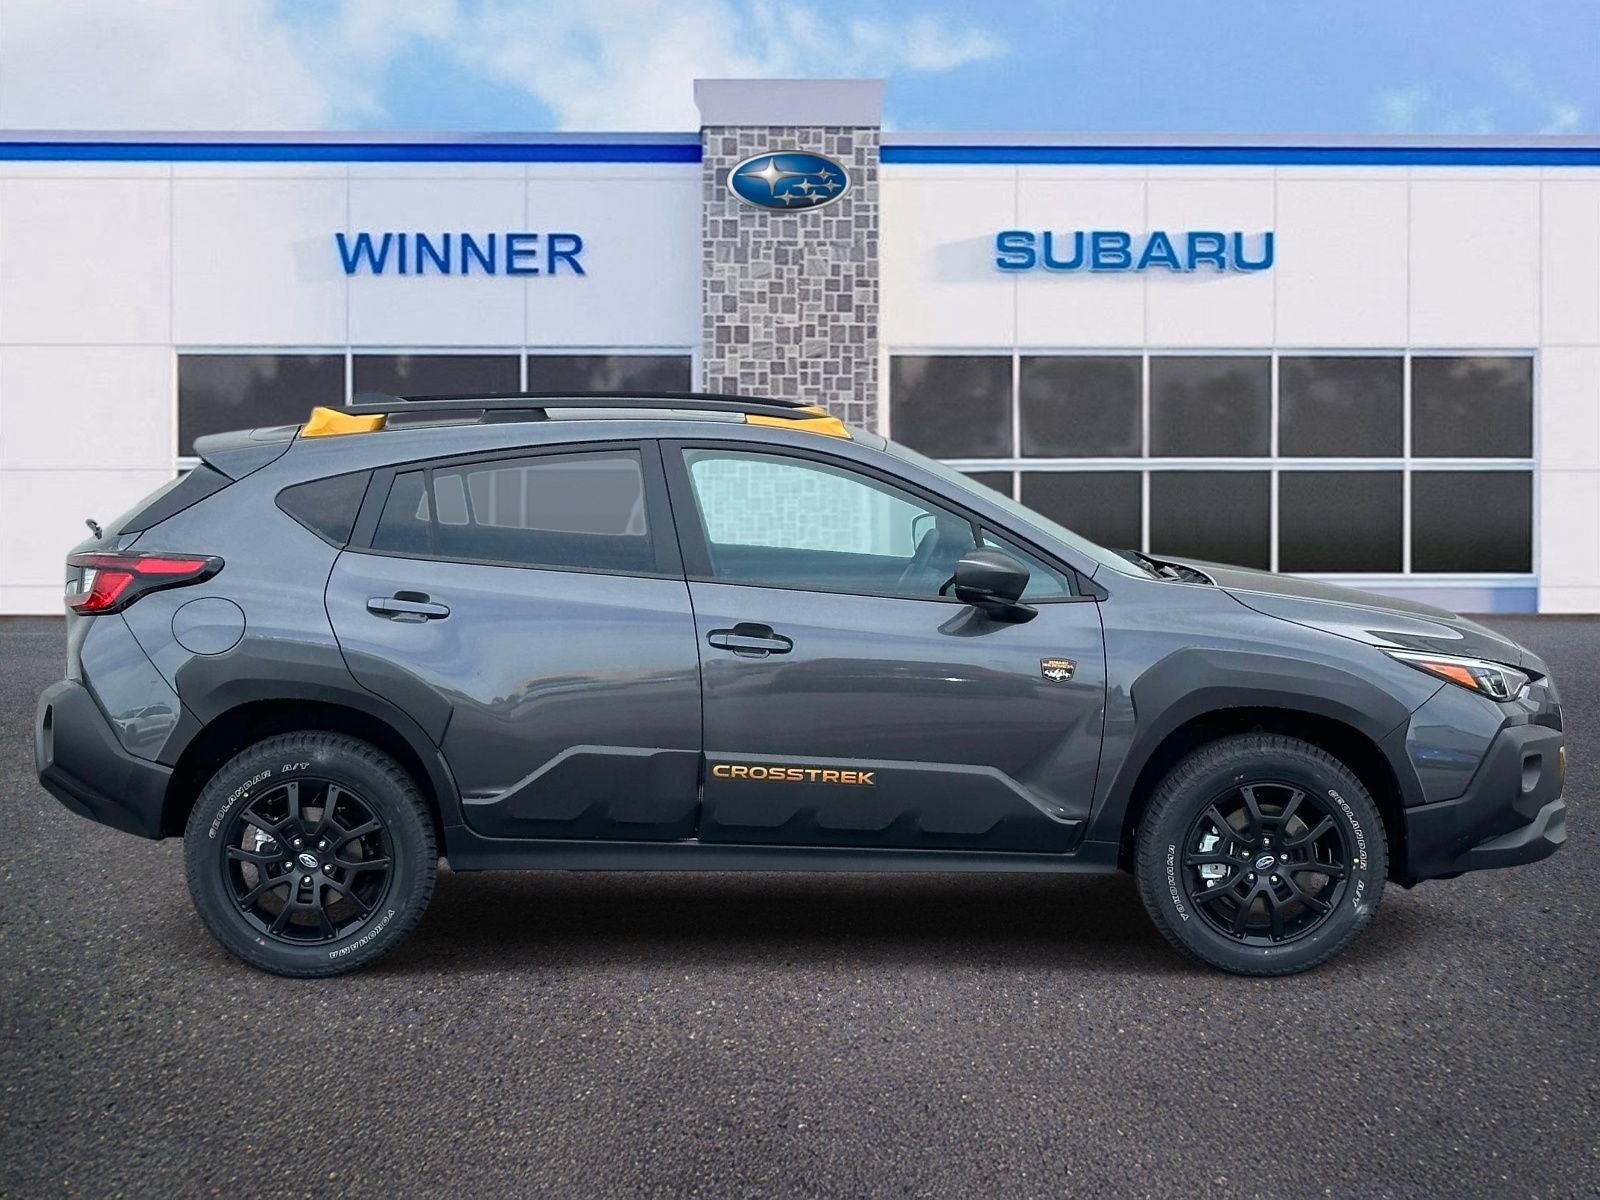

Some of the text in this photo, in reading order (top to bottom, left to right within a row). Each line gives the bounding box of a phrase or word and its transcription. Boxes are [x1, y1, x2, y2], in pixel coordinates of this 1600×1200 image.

[335, 233, 586, 275] WINNER
[996, 231, 1274, 270] SUBARU
[713, 764, 875, 785] CROSSTREK
[208, 761, 310, 839] GEOLANDAR A/T
[1328, 789, 1367, 870] GEOLANDAR
[1166, 844, 1189, 921] YOKOHAMA
[329, 909, 395, 959] YOKOHAMA
